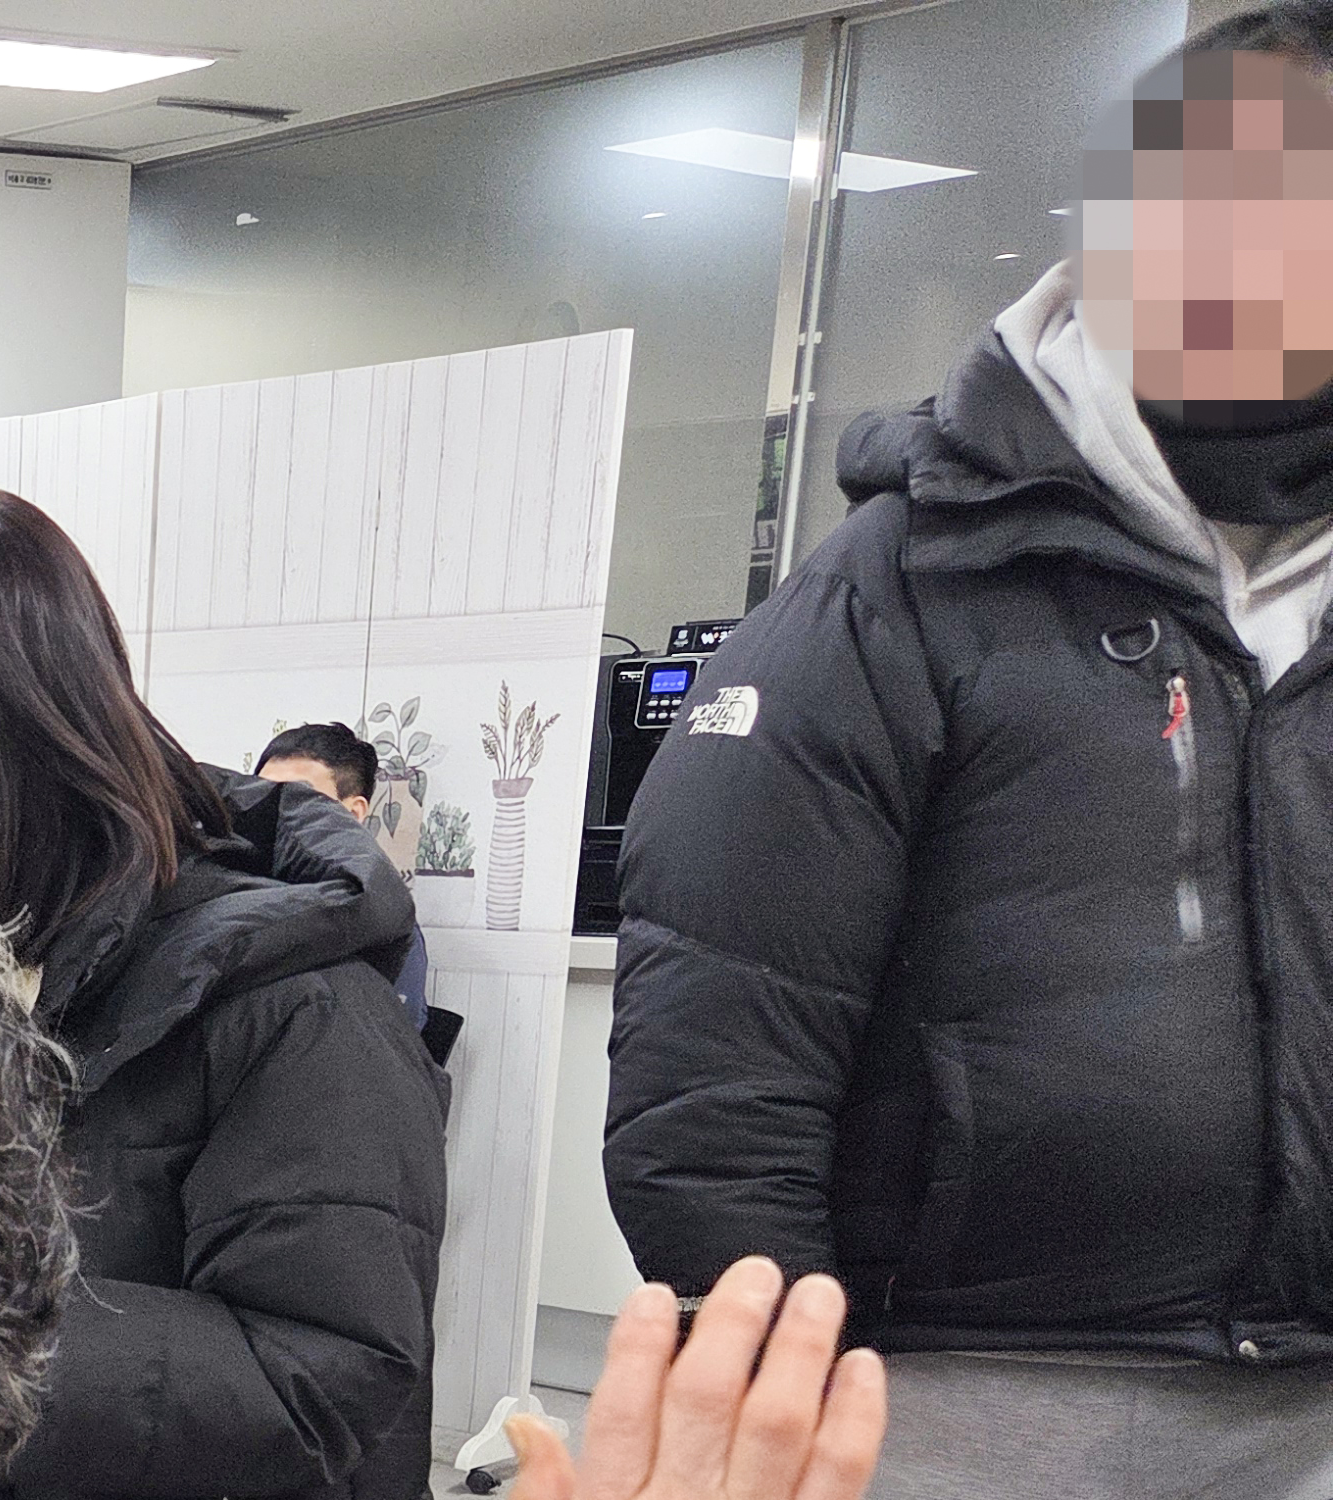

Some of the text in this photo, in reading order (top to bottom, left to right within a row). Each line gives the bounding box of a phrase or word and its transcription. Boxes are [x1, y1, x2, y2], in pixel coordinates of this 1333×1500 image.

[716, 687, 742, 704] THE
[688, 703, 734, 722] NORTH
[688, 718, 730, 735] FACE
